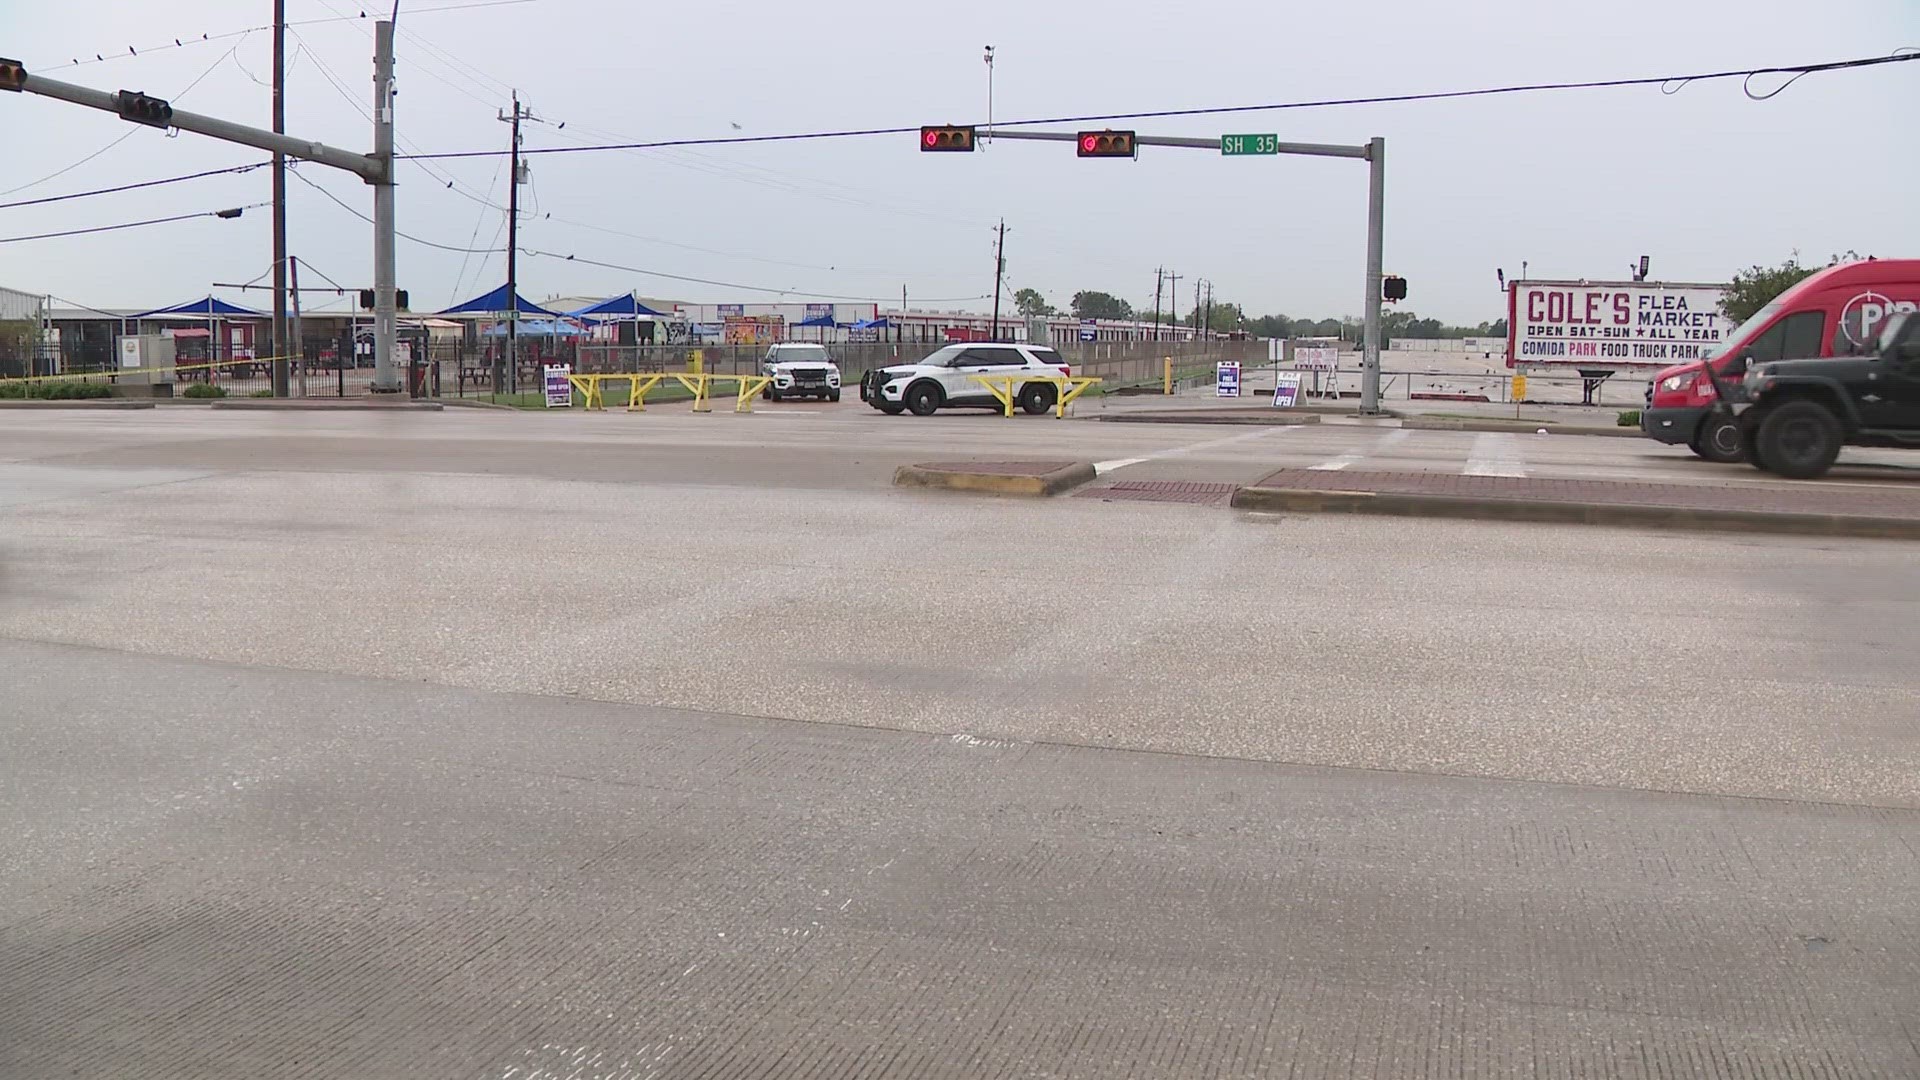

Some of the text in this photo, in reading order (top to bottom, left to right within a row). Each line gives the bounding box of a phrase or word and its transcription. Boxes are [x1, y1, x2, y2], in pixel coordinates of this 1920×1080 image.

[1225, 136, 1274, 153] SH 35
[1528, 291, 1630, 325] COLE'S
[1638, 295, 1688, 310] FLEA
[1638, 312, 1718, 327] MARKET
[1527, 326, 1563, 336] OPEN
[1570, 326, 1630, 337] SAT-SUN
[1649, 329, 1675, 339] ALL
[1684, 329, 1719, 340] YEAR
[1522, 341, 1565, 356] COMIDA
[1569, 342, 1597, 356] PARK
[1601, 343, 1629, 358] FOOD
[1633, 343, 1667, 358] TRUCK
[1671, 344, 1699, 359] PARK
[1276, 395, 1292, 406] OPEN
